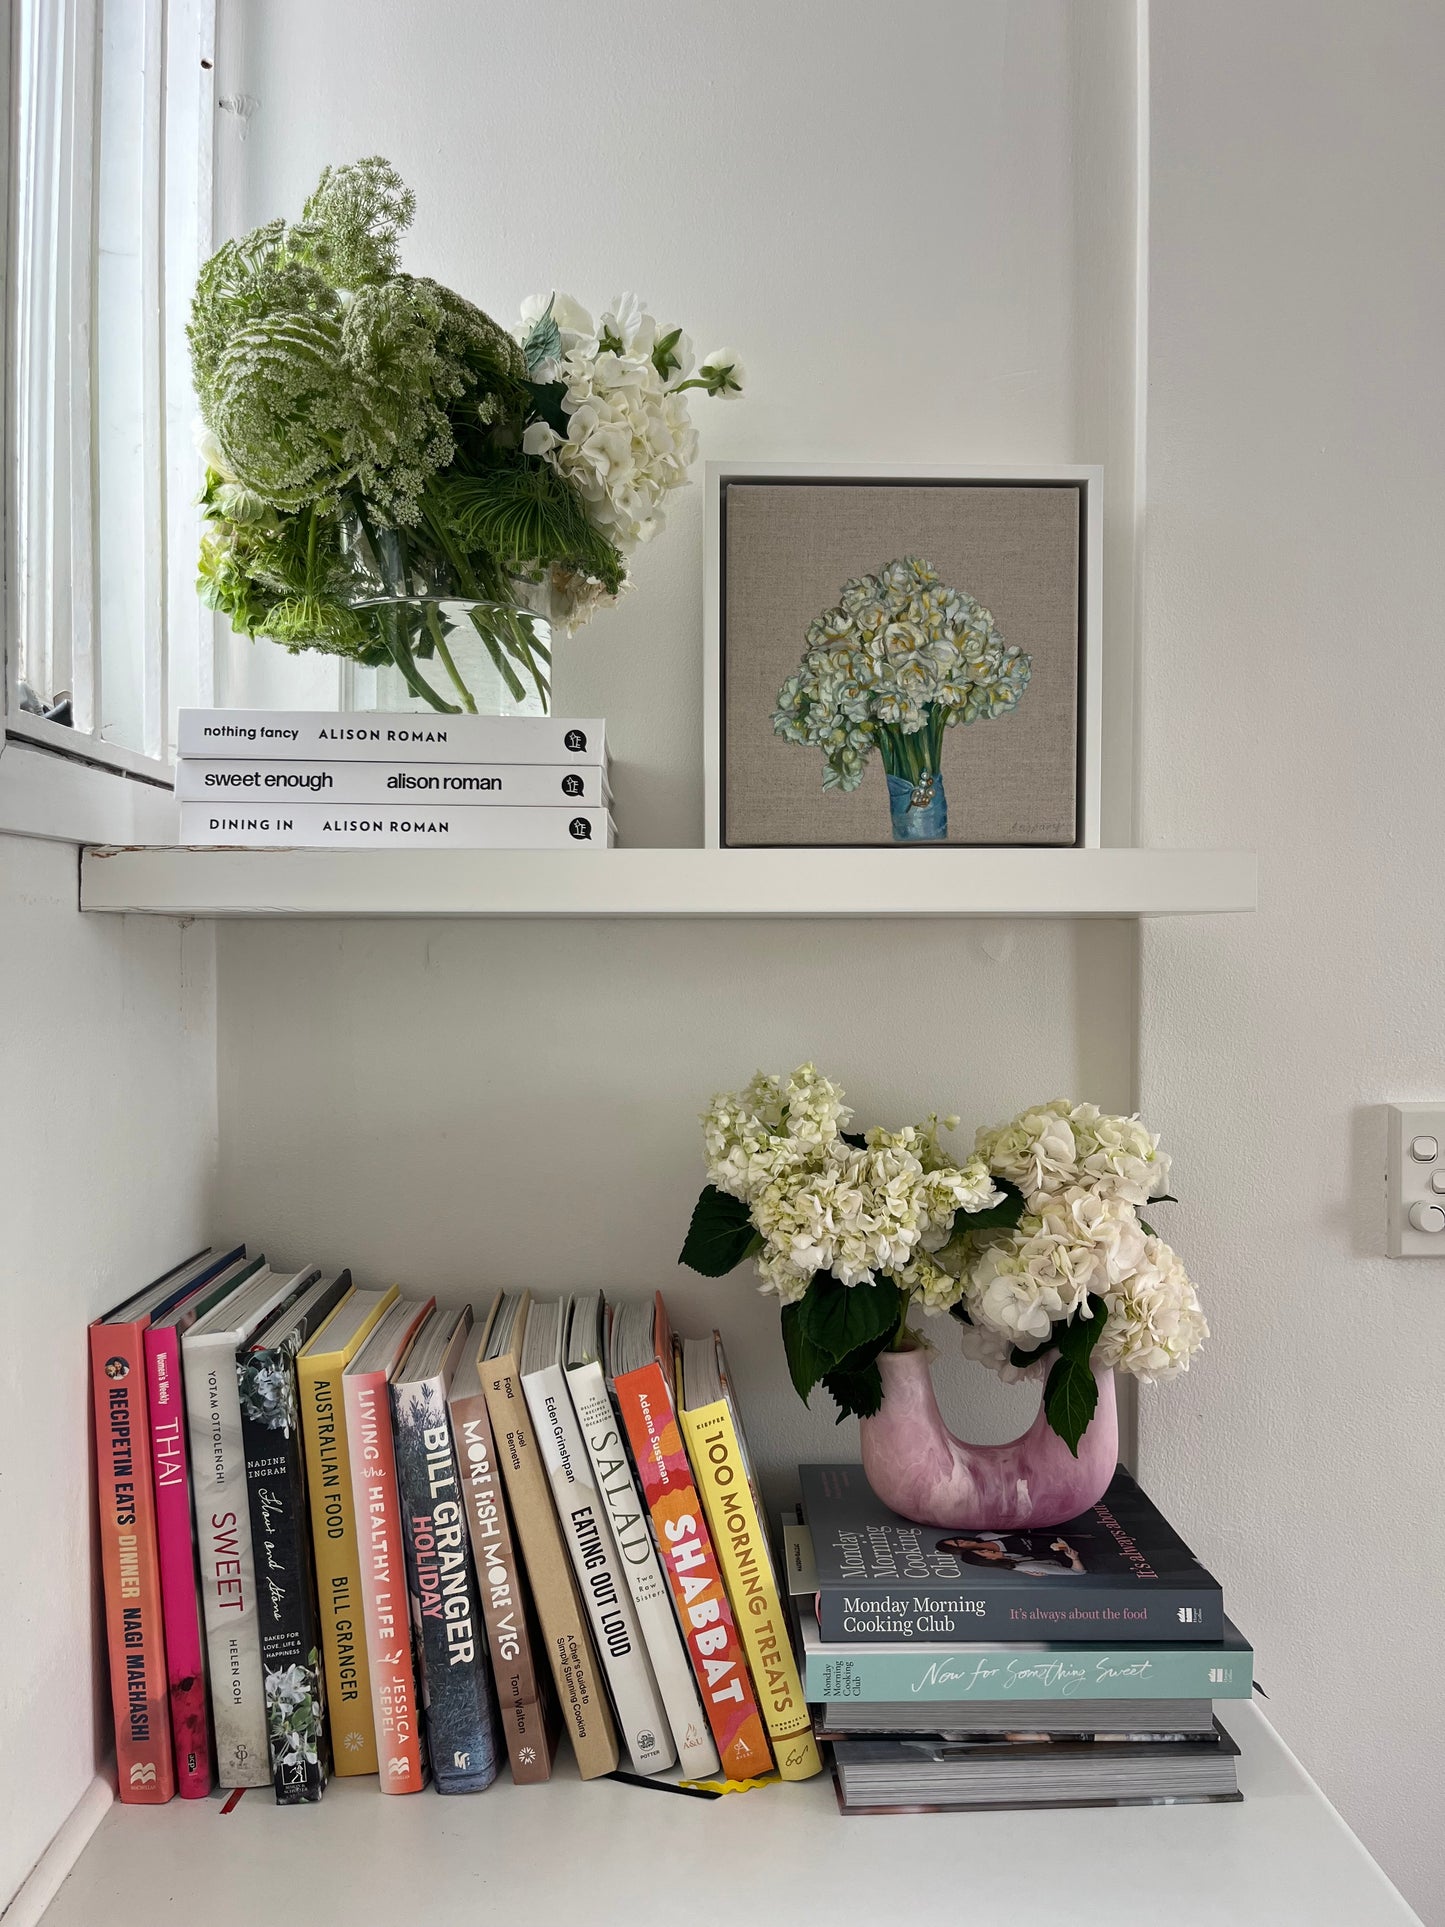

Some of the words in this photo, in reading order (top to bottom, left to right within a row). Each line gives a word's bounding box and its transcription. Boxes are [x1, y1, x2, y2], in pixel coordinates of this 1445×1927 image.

[204, 726, 256, 740] nothing
[260, 727, 299, 741] fancy
[318, 729, 380, 741] ALISON
[386, 730, 448, 742] ROMAN
[204, 772, 261, 787] sweet
[264, 772, 334, 791] enough
[386, 773, 440, 790] alison
[444, 776, 502, 790] roman
[209, 818, 270, 830] DINING
[276, 820, 294, 830] IN
[322, 820, 383, 832] ALISON
[390, 821, 450, 833] ROMAN
[156, 1352, 168, 1381] Women's
[158, 1381, 168, 1405] Weekly
[208, 1370, 219, 1409] YOTAM
[494, 1380, 500, 1392] by
[504, 1376, 514, 1399] Food
[580, 1398, 607, 1412] DELICIOUS
[586, 1415, 612, 1427] OCCASION
[696, 1416, 726, 1430] KIEFFER
[109, 1388, 132, 1477] RECIPETIN
[314, 1380, 340, 1488] AUSTRALIAN
[358, 1389, 380, 1460] LIVING
[516, 1429, 527, 1448] Joel
[544, 1396, 558, 1426] Eden
[554, 1426, 575, 1484] Grinshpan
[638, 1393, 654, 1434] Adeena
[650, 1434, 670, 1485] Sussman
[155, 1416, 183, 1486] THAI
[211, 1412, 225, 1484] OTTOLENGHI
[248, 1456, 286, 1469] NADINE
[424, 1424, 454, 1499] BILL
[462, 1419, 492, 1486] MORE
[506, 1432, 520, 1470] Bennetts
[248, 1466, 286, 1478] INGRAM
[360, 1466, 386, 1478] the
[115, 1482, 136, 1526] EATS
[258, 1487, 284, 1535] Flour
[324, 1494, 344, 1538] FOOD
[590, 1430, 651, 1566] SALAD
[368, 1486, 390, 1582] HEALTHY
[571, 1506, 606, 1570] EATING
[862, 1525, 900, 1578] Morning
[1111, 1530, 1145, 1562] always
[118, 1535, 140, 1598] DINNER
[211, 1512, 244, 1612] SWEET
[263, 1541, 286, 1571] and
[412, 1516, 444, 1620] HOLIDAY
[705, 1430, 734, 1486] 100
[721, 1492, 768, 1616] MORNING
[754, 1619, 793, 1712] TREATS
[832, 1529, 868, 1578] Monday
[894, 1528, 930, 1578] Cooking
[1130, 1562, 1158, 1579] It's
[433, 1500, 475, 1666] GRANGER
[482, 1542, 512, 1609] MORE
[590, 1572, 618, 1607] OUT
[636, 1574, 654, 1583] Two
[266, 1576, 286, 1622] Stone
[332, 1576, 348, 1614] BILL
[635, 1589, 665, 1603] Sisters
[665, 1514, 745, 1704] SHABBAT
[844, 1596, 910, 1616] Monday
[913, 1596, 986, 1616] Morning
[123, 1607, 144, 1648] NAGI
[375, 1594, 394, 1640] LIFE
[844, 1616, 914, 1636] Cooking
[916, 1615, 955, 1632] Club
[1010, 1608, 1028, 1620] It's
[1029, 1608, 1067, 1622] always
[1068, 1608, 1100, 1620] about
[1102, 1608, 1121, 1620] the
[1122, 1608, 1148, 1620] food
[264, 1634, 285, 1642] BAKED
[496, 1612, 520, 1661] VEG
[600, 1610, 632, 1658] LOUD
[229, 1638, 241, 1676] HELEN
[266, 1648, 300, 1658] HAPPINESS
[336, 1620, 358, 1702] GRANGER
[568, 1642, 581, 1670] Chef's
[232, 1679, 242, 1705] GOH
[510, 1674, 520, 1697] Tom
[556, 1638, 568, 1666] Simply
[564, 1666, 578, 1704] Stunning
[573, 1704, 586, 1738] Cooking
[576, 1670, 587, 1694] Guide
[824, 1664, 832, 1696] Monday
[833, 1660, 844, 1696] Morning
[843, 1661, 854, 1696] Cooking
[852, 1676, 862, 1696] Club
[912, 1657, 964, 1692] Now
[964, 1658, 1000, 1690] for
[1004, 1658, 1086, 1695] Something
[1096, 1657, 1153, 1683] Sweet
[126, 1654, 150, 1742] MAEHASHI
[378, 1686, 394, 1736] SEPEL
[392, 1676, 409, 1744] JESSICA
[514, 1697, 526, 1734] Walton
[581, 1695, 589, 1704] to
[640, 1750, 660, 1760] POTTER
[683, 1737, 704, 1750] A&U
